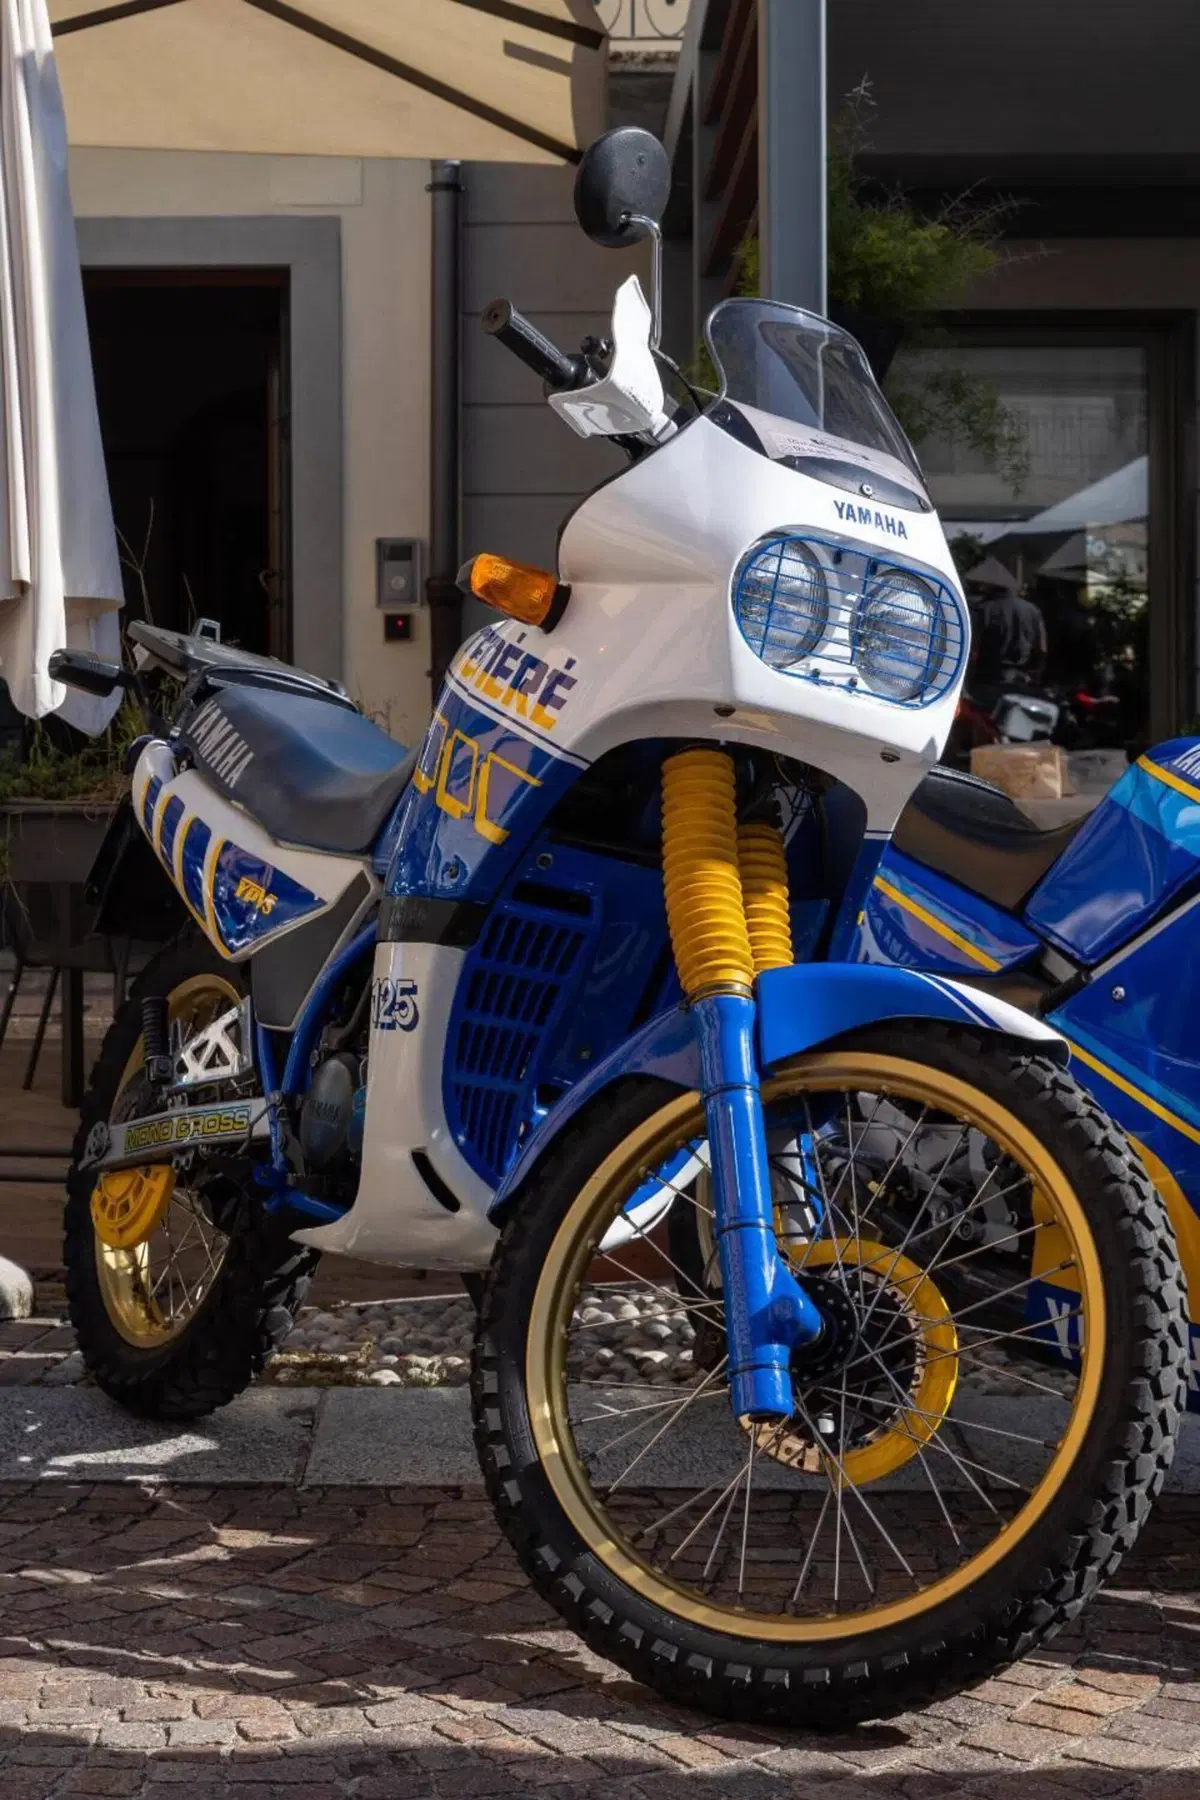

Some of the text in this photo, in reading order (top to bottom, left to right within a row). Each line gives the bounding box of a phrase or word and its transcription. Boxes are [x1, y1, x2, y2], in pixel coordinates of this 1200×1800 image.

[833, 499, 908, 540] YAMAHA
[186, 699, 255, 789] YAMAHA
[234, 876, 279, 915] YPVS
[370, 976, 420, 1033] 125
[126, 1109, 249, 1150] MONO CROSS
